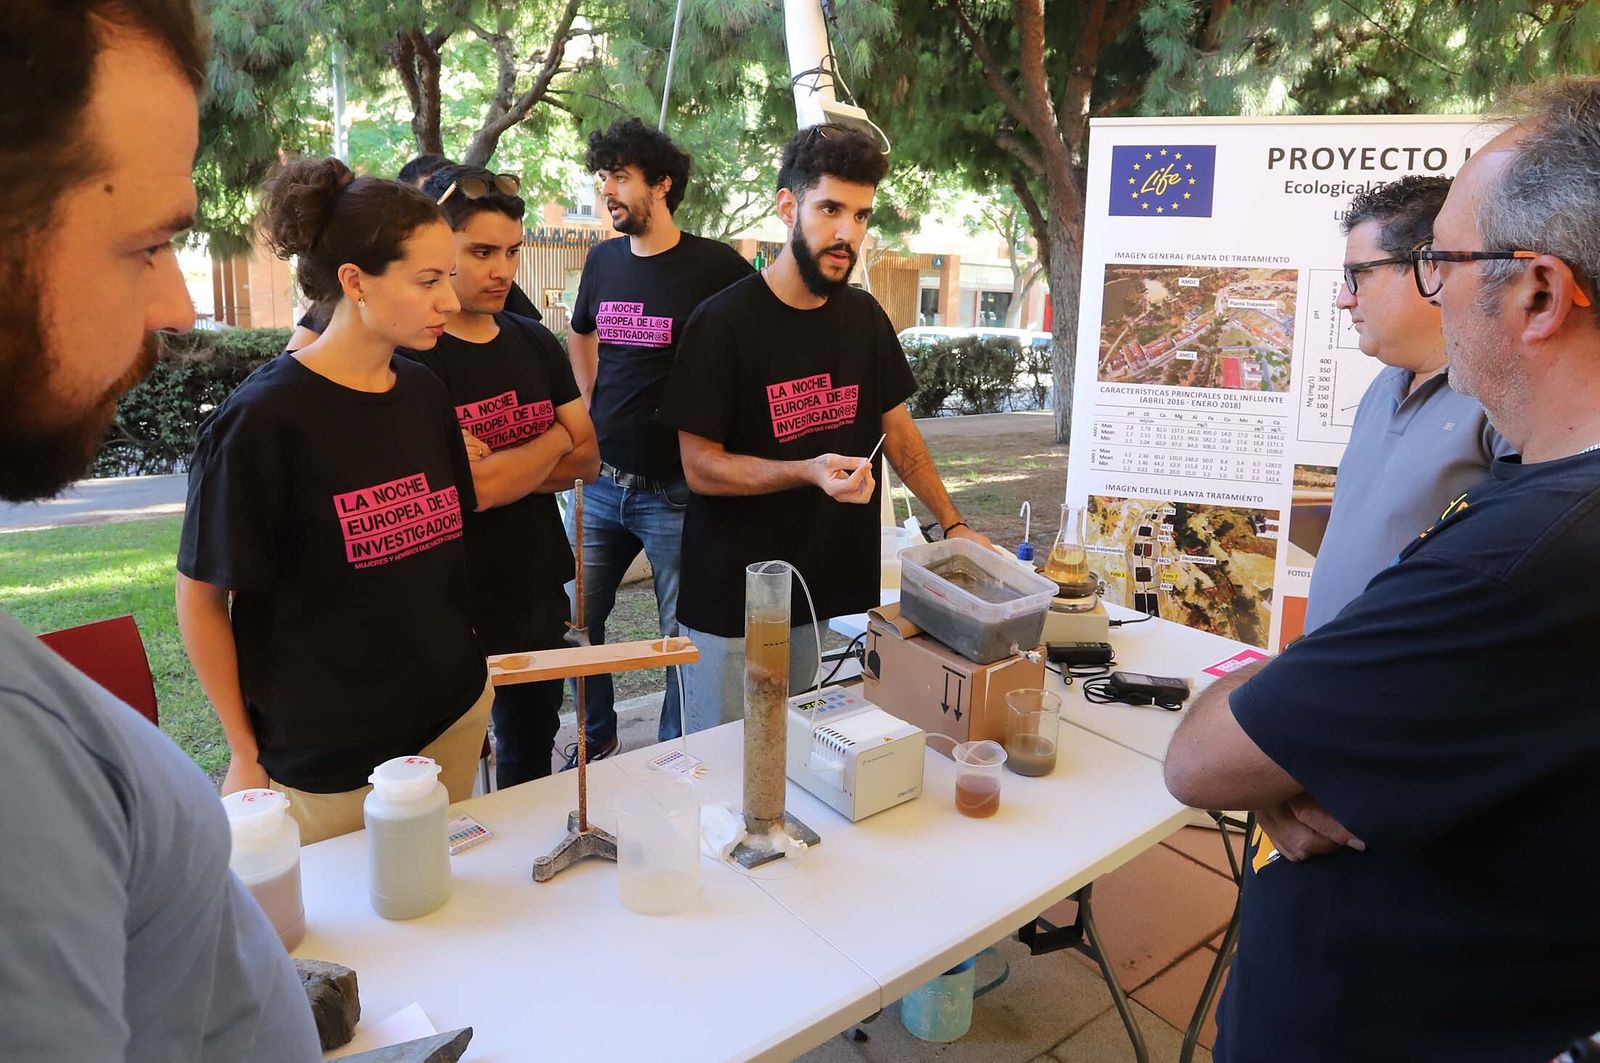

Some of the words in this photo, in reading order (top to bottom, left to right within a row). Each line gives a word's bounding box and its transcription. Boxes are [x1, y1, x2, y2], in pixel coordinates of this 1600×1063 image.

[1267, 147, 1447, 171] PROYECTO
[1140, 163, 1181, 195] Life
[1284, 180, 1370, 198] Ecological
[1219, 254, 1231, 262] DE
[1232, 255, 1290, 264] TRATAMIENTO
[600, 304, 609, 312] LA
[612, 304, 642, 314] NOCHE
[1313, 310, 1320, 320] pH
[597, 315, 634, 326] EUROPEA
[637, 318, 648, 327] DE
[649, 319, 669, 329] L@S
[599, 328, 669, 342] NVESTIGADOR@S
[770, 386, 787, 400] LA
[792, 376, 828, 394] NOCHE
[1100, 386, 1170, 396] CARACTERÍSTICAS
[1171, 390, 1221, 400] PRINCIPALES
[1240, 394, 1284, 403] INFLUENTE
[773, 395, 821, 417] EUROPEA
[826, 391, 841, 404] DE
[840, 388, 857, 401] L@S
[1140, 396, 1165, 404] (ABRIL
[1167, 398, 1185, 406] 2016
[1220, 402, 1241, 410] 2018)
[1306, 397, 1314, 407] Mg
[459, 408, 473, 421] A
[513, 409, 529, 422] DE
[532, 403, 552, 417] L@S
[777, 404, 856, 434] INVESTIGADOR@S
[340, 494, 369, 514] LA
[372, 477, 425, 505] NOCHE
[1105, 484, 1137, 494] IMAGEN
[1139, 487, 1172, 497] DETALLE
[1173, 489, 1204, 499] PLANTA
[1206, 491, 1264, 503] TRATAMIENTO
[347, 502, 425, 536] EUROPEA
[426, 494, 445, 513] DE
[355, 558, 389, 569] MUJERES
[1181, 556, 1215, 564] Decantadores
